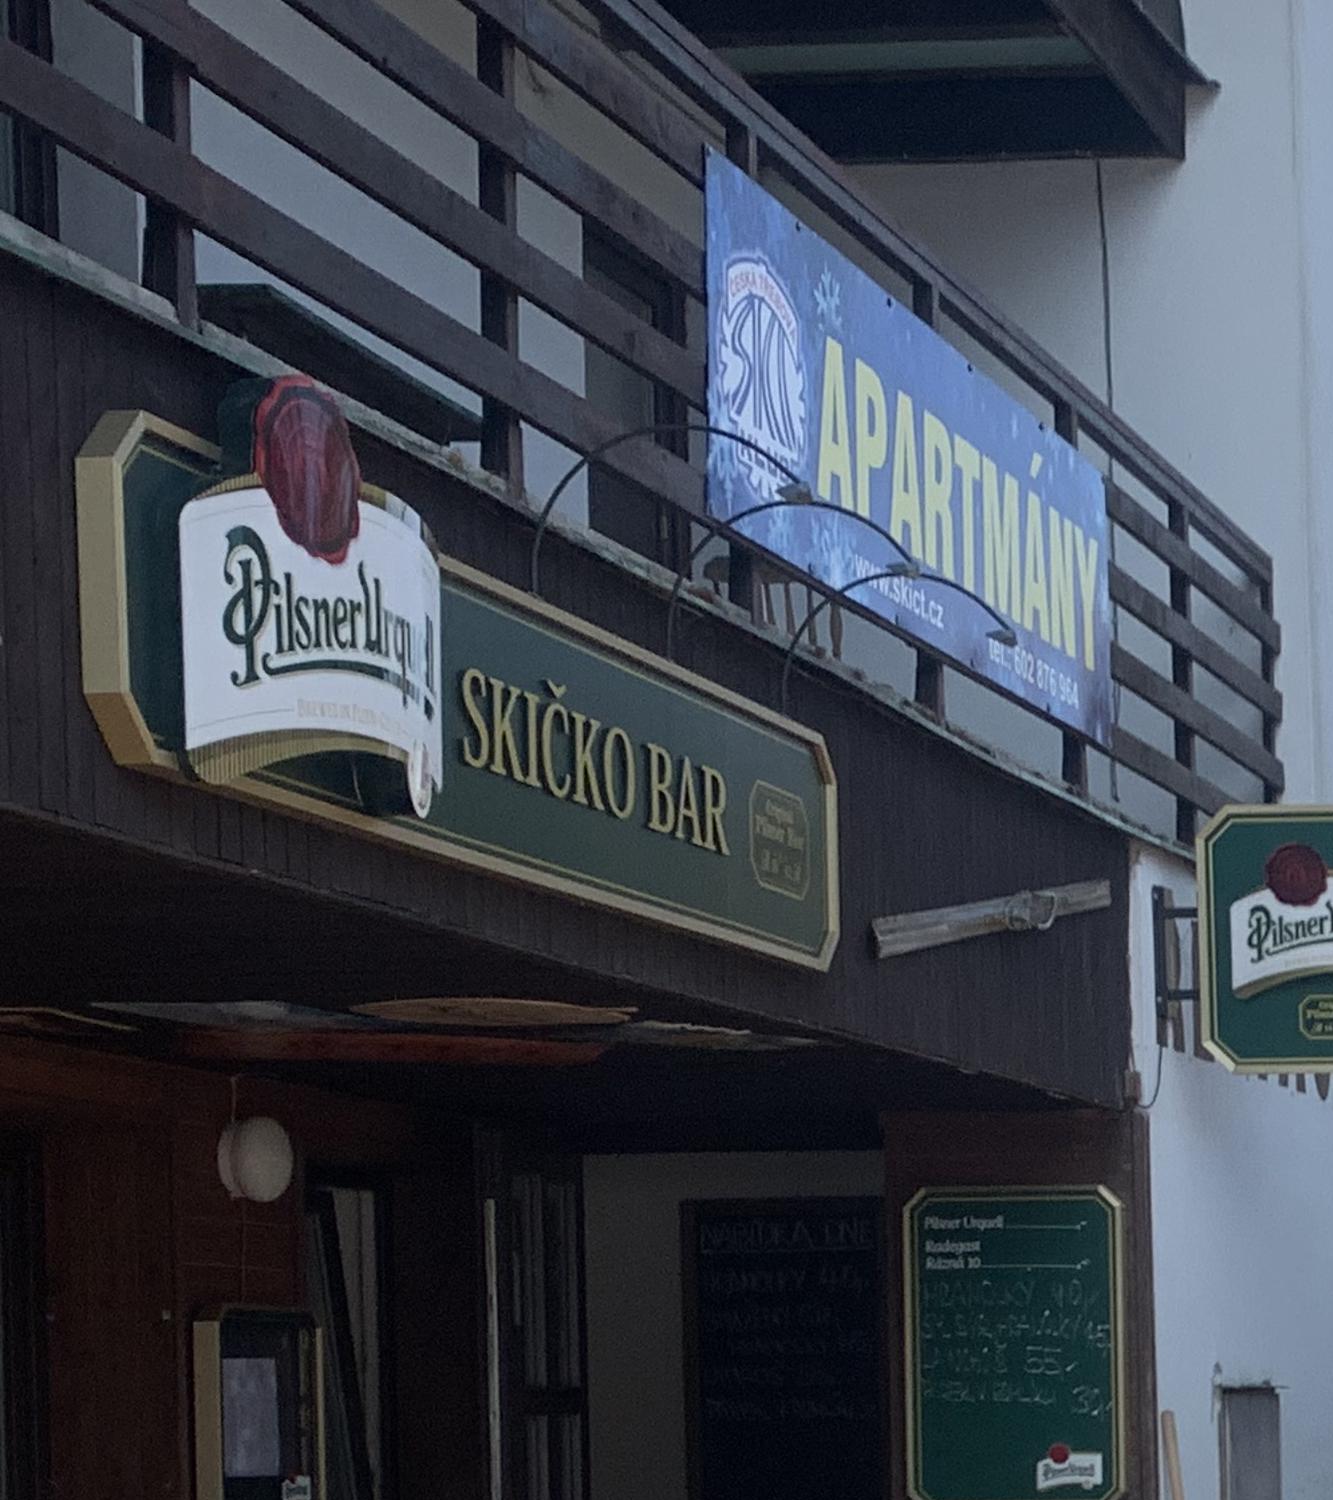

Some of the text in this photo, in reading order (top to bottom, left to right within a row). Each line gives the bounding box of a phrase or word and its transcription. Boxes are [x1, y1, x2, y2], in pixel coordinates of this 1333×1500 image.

[817, 336, 1100, 671] APARTMÁNY
[222, 525, 434, 710] Pilsner Urqull
[461, 667, 637, 820] SKIČKO
[646, 742, 731, 856] BAR
[1246, 904, 1329, 963] Pilsner
